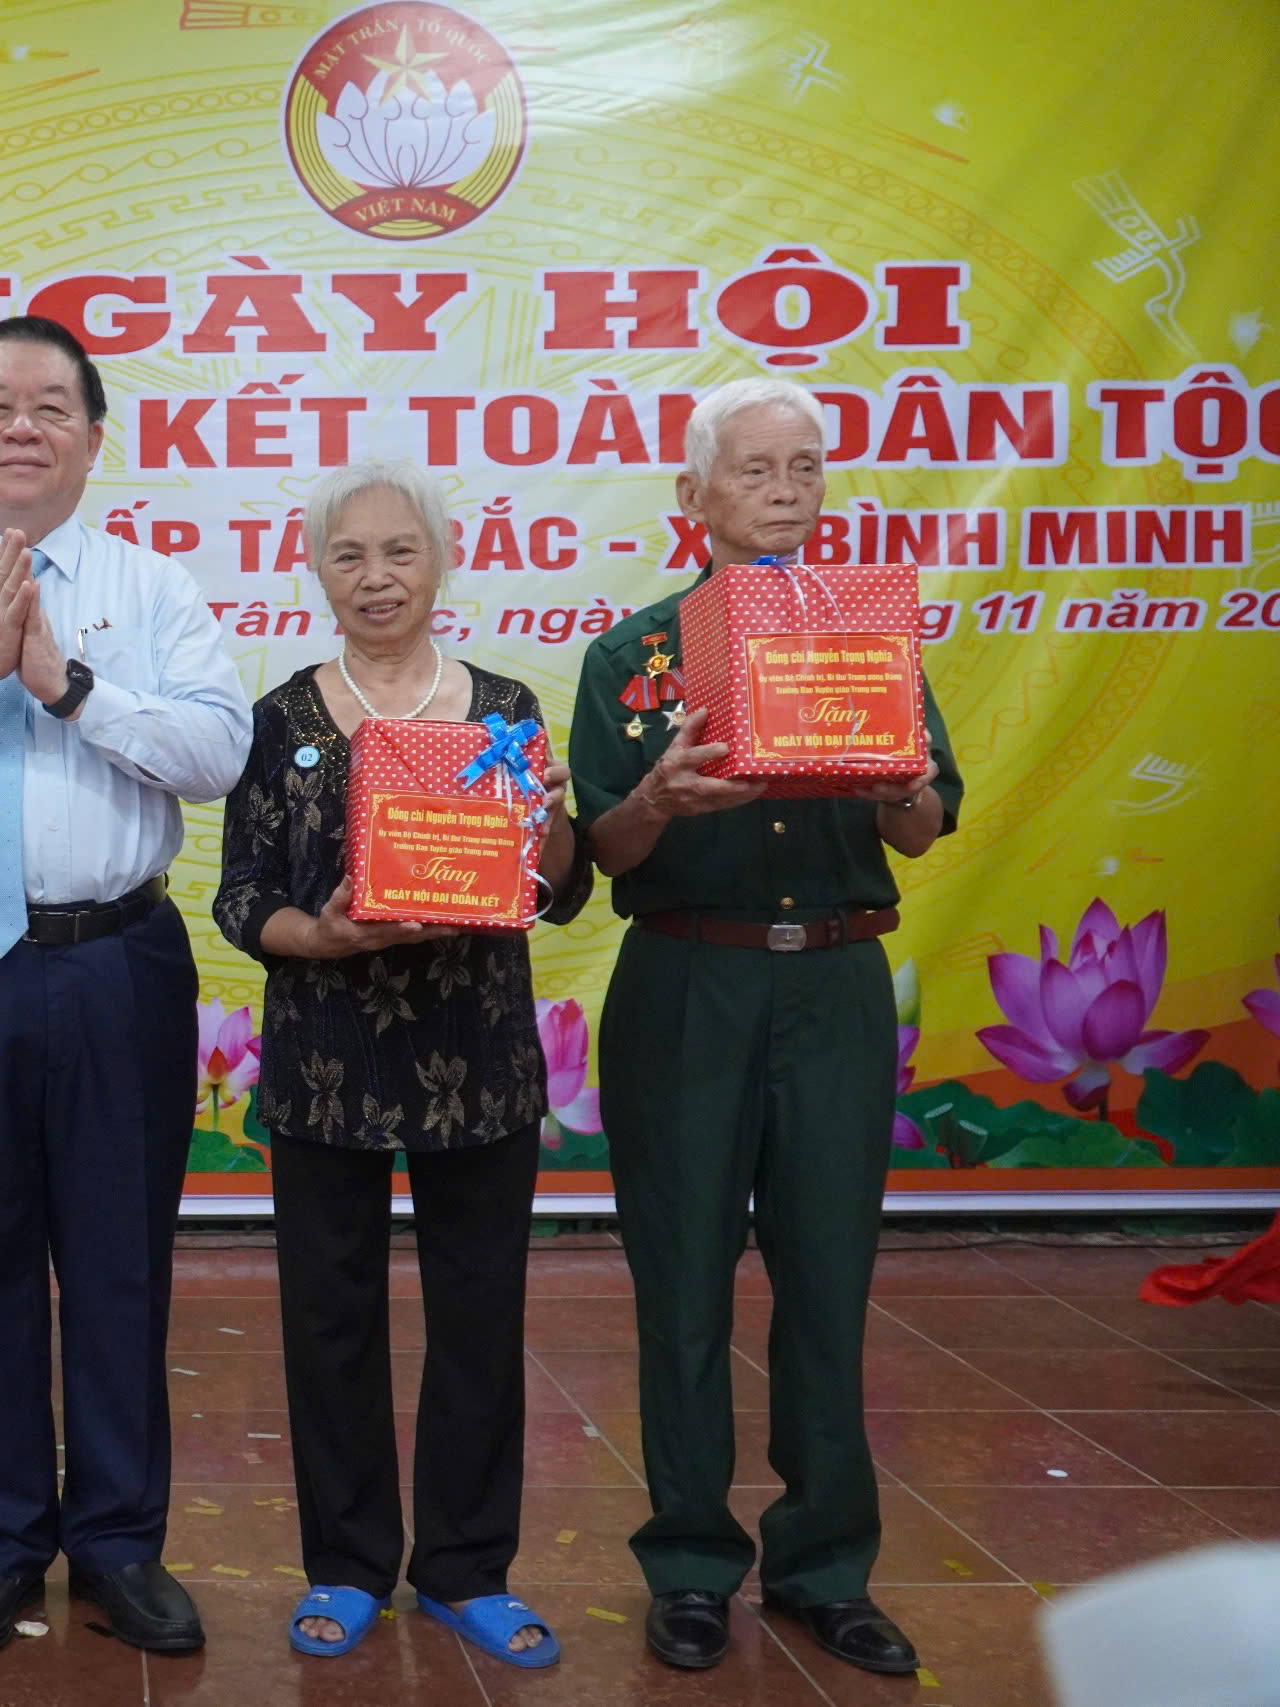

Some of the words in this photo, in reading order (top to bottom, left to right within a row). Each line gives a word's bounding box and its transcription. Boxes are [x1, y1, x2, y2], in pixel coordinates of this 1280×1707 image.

[355, 197, 404, 222] VIỆT
[412, 197, 457, 222] NAM
[544, 249, 960, 366] HỘI
[138, 374, 367, 468] KẾT
[811, 375, 1054, 461] DÂN
[1100, 371, 1280, 475] TỘ
[229, 508, 312, 572] TÂ
[803, 502, 998, 566] BÌNH
[1028, 510, 1243, 565] MINH
[207, 601, 311, 636] Tân
[497, 599, 636, 643] ngà
[980, 595, 1037, 629] 11
[1064, 592, 1200, 628] năm
[799, 697, 870, 732] Tặng
[411, 856, 479, 892] Tặng
[384, 888, 410, 900] NGÀY
[481, 894, 499, 907] KẾT
